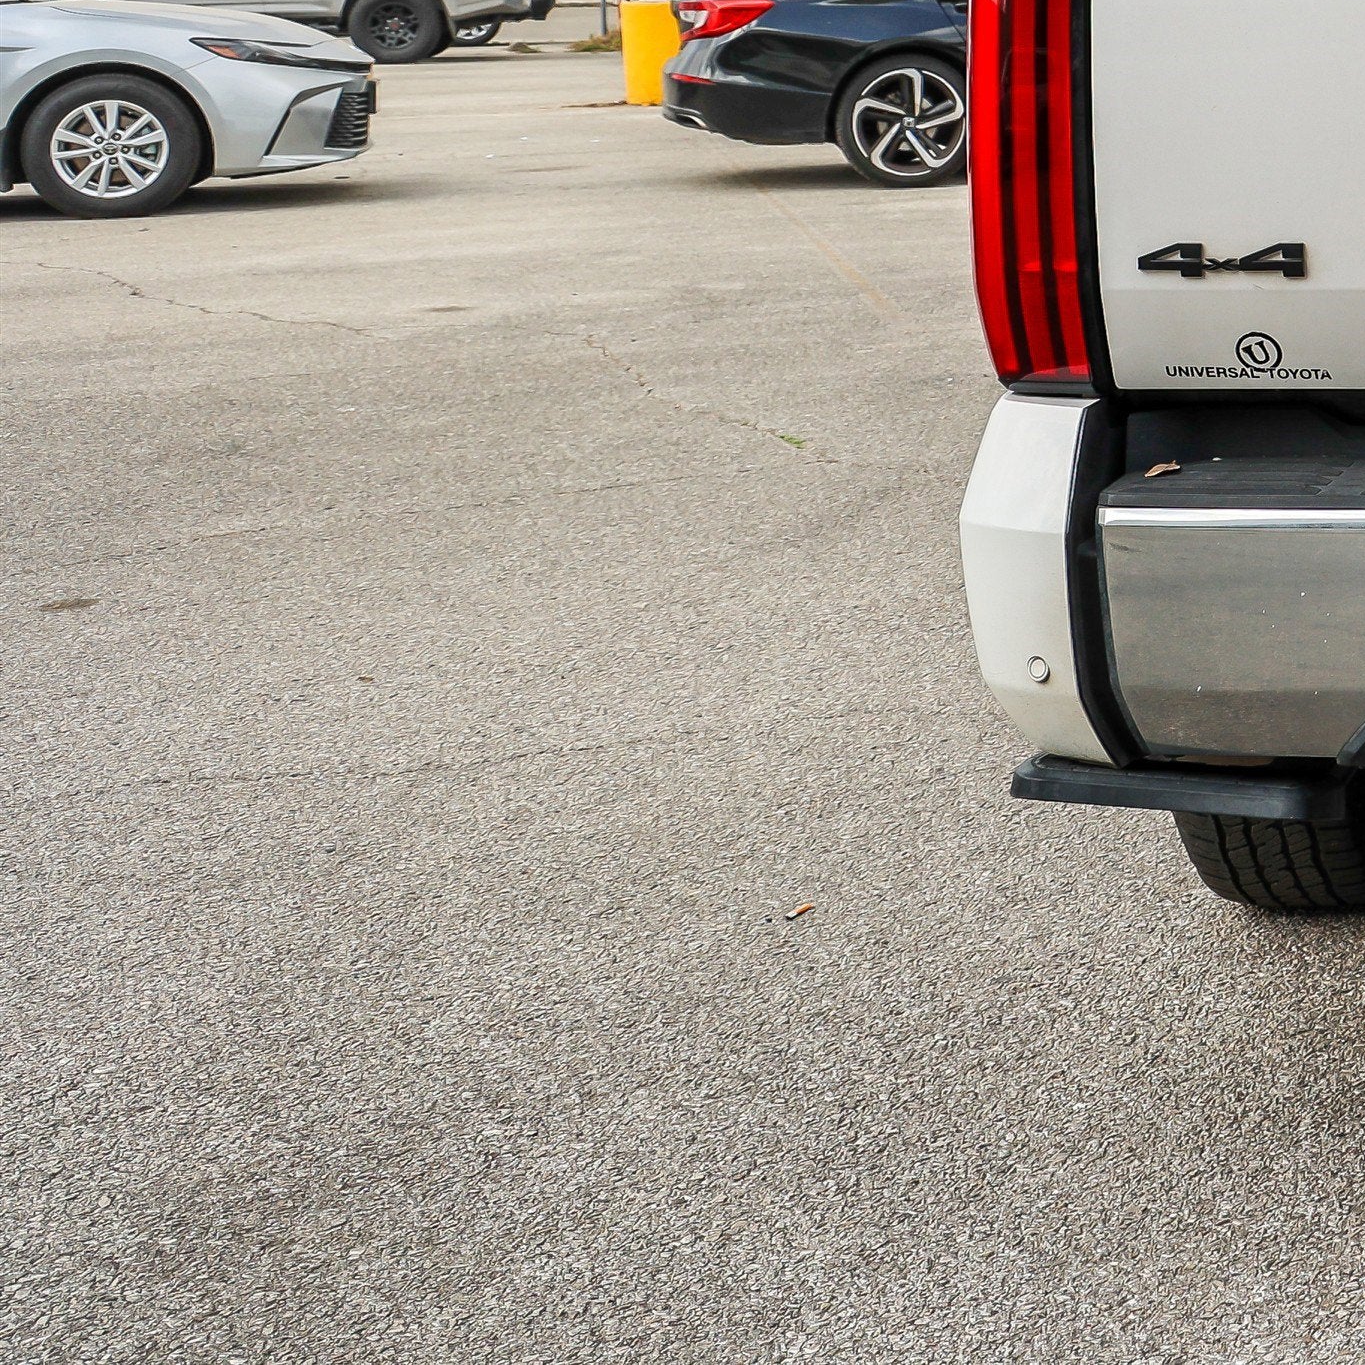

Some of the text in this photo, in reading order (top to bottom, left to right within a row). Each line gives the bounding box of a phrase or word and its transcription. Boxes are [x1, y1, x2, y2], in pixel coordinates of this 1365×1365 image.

[1138, 242, 1306, 278] 4x4
[1165, 365, 1332, 380] UNIVERSAL TOYOTA
